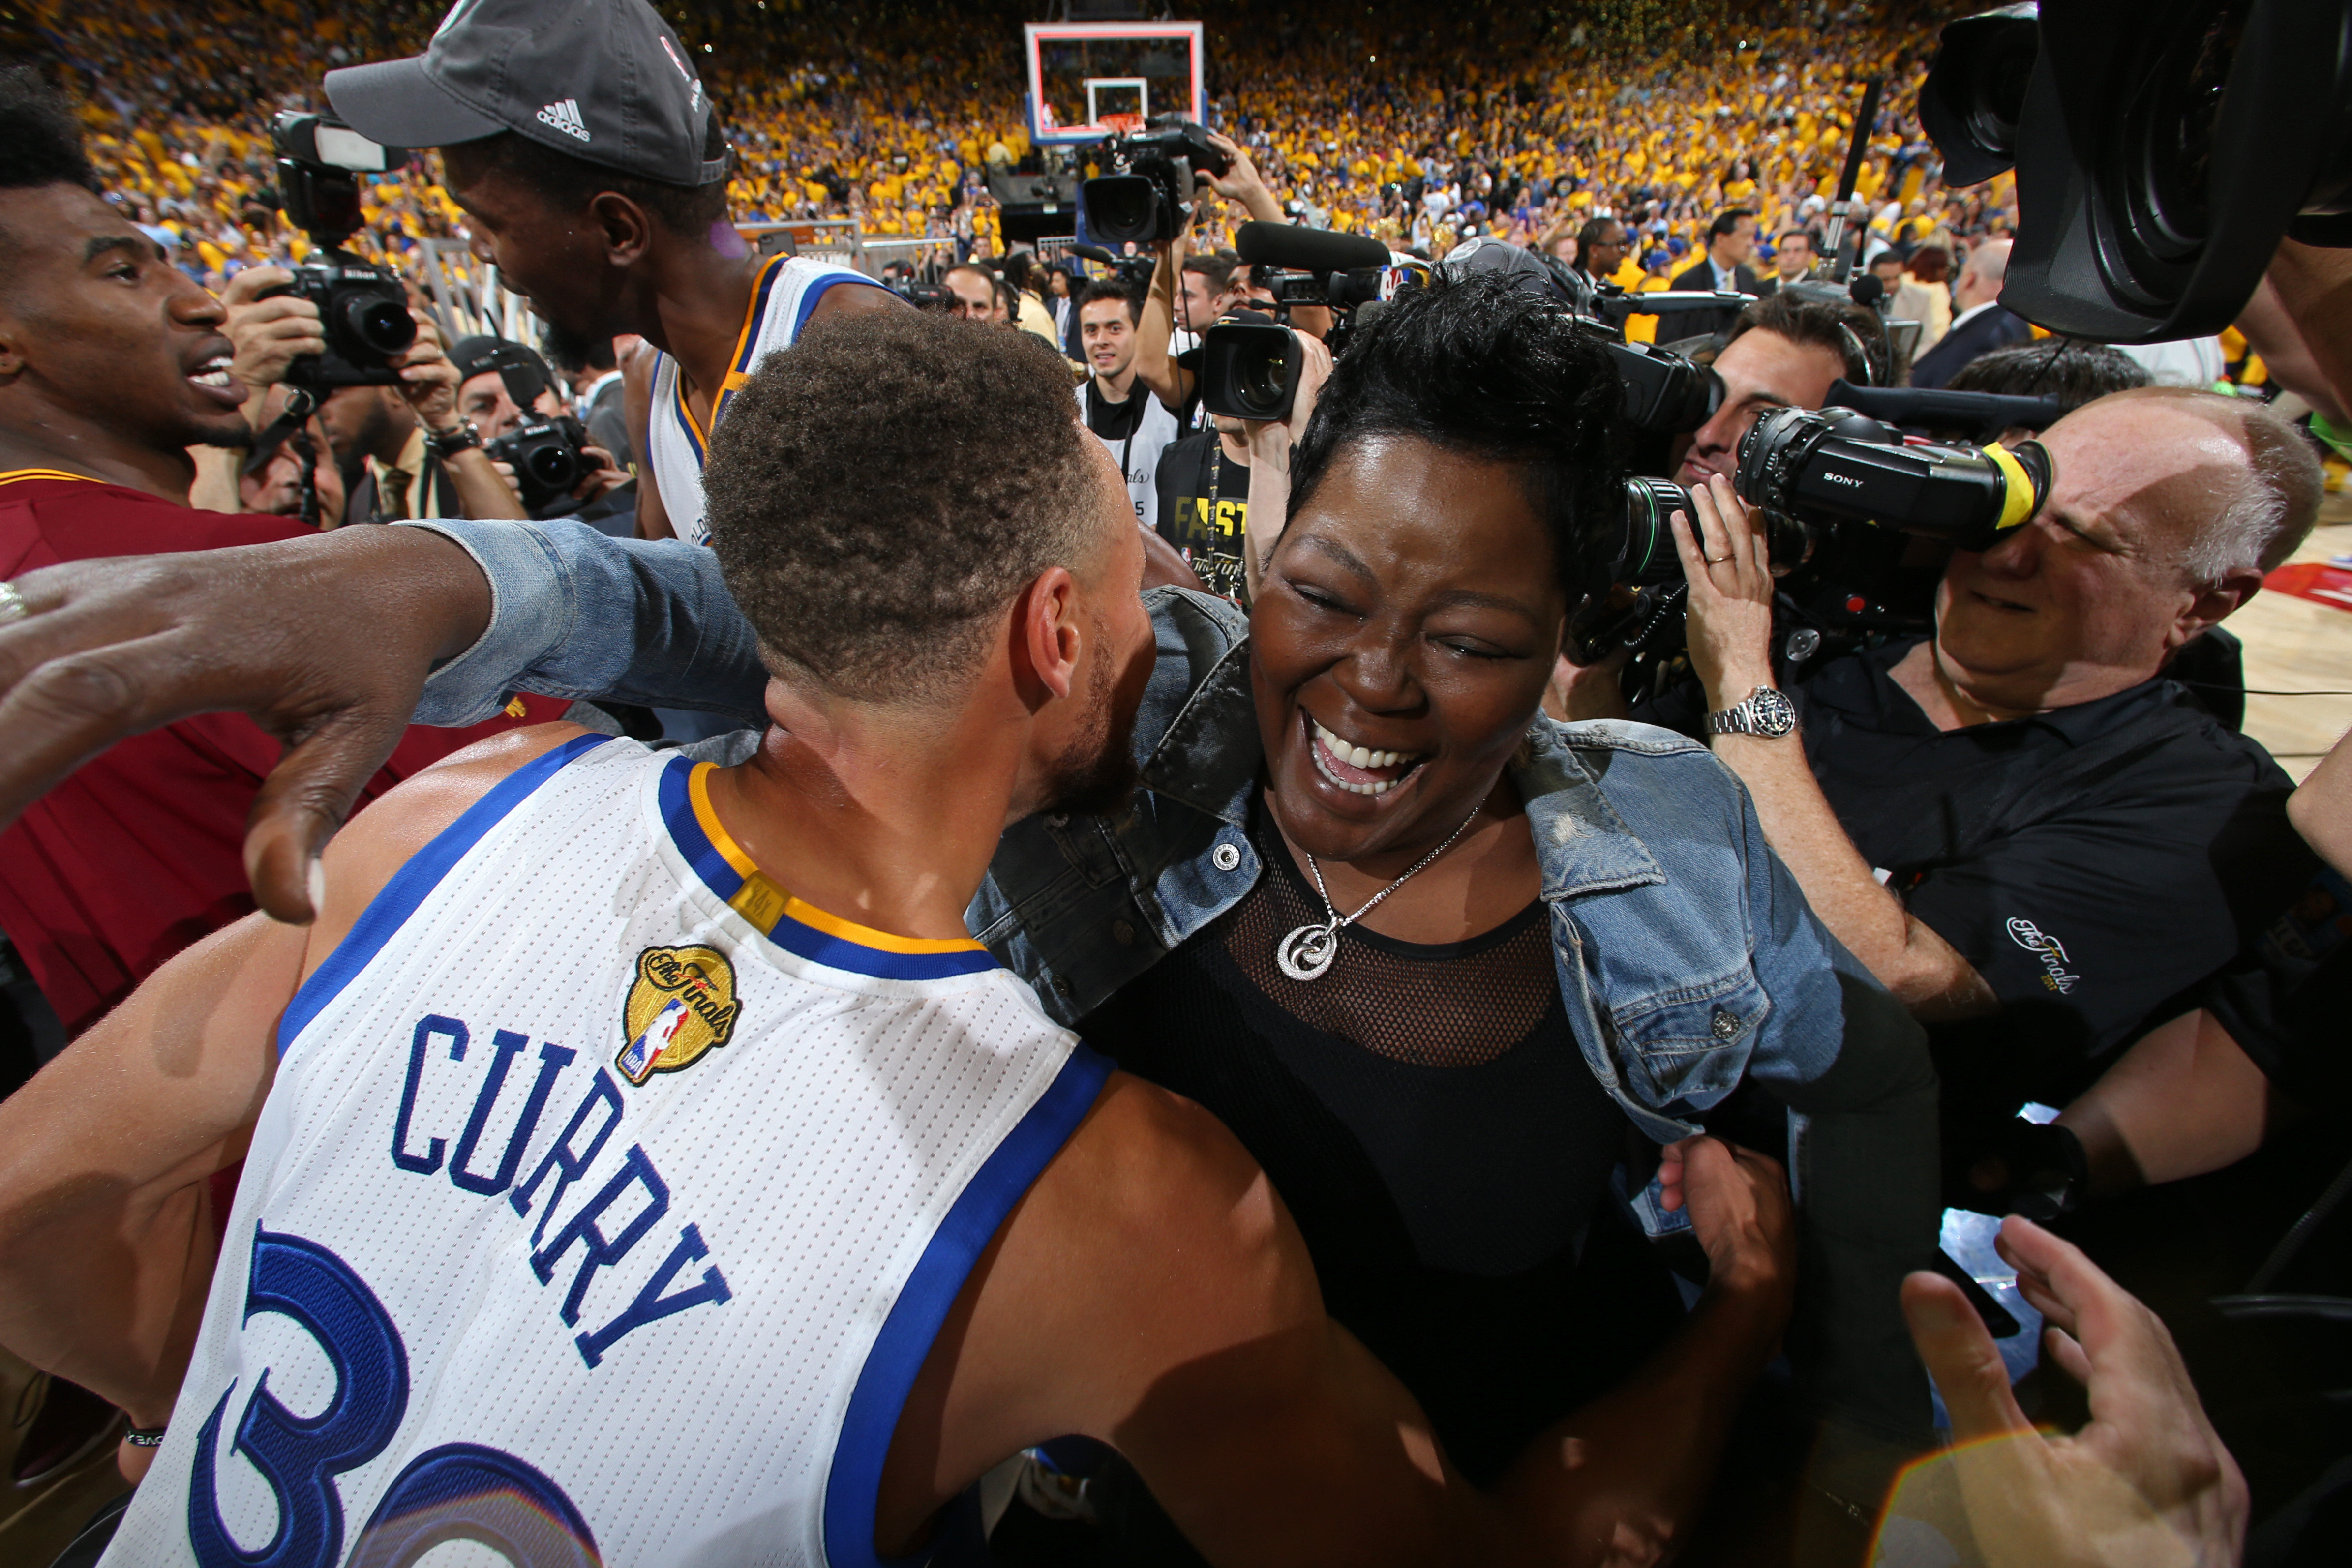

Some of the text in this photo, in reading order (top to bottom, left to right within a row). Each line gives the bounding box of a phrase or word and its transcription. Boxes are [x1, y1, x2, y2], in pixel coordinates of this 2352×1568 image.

[536, 110, 591, 142] adidas
[344, 269, 378, 280] Nikon
[524, 425, 551, 436] Nikon
[1823, 472, 1864, 488] SONY
[2006, 917, 2081, 994] The Finals
[2041, 975, 2058, 991] 2017
[645, 953, 736, 1037] The Finals
[623, 1051, 643, 1071] NBA
[391, 1013, 733, 1369] CURRY
